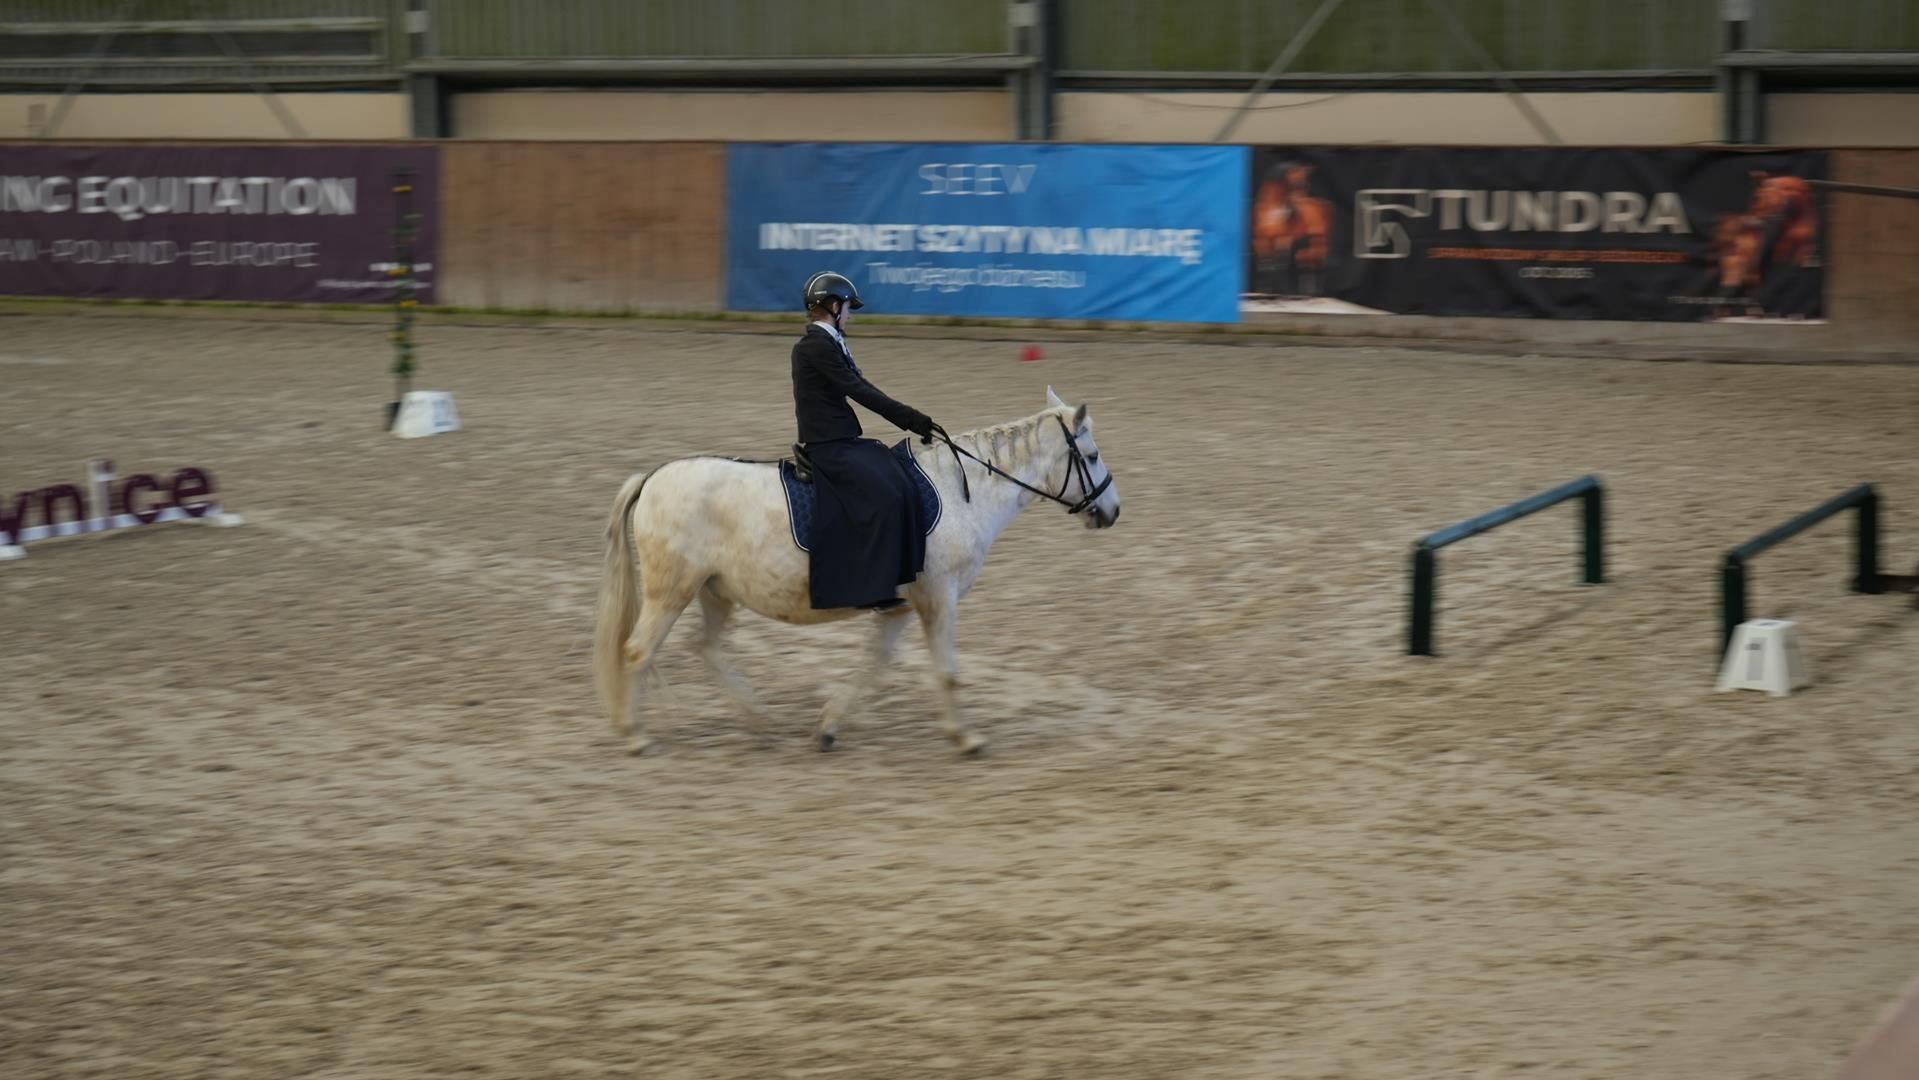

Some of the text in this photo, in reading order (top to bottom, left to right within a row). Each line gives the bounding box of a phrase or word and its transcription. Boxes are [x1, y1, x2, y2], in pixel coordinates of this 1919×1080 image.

[77, 176, 357, 221] EQUITATION
[1430, 189, 1692, 234] TUNDRA
[191, 241, 320, 267] EUROPE
[760, 223, 917, 251] INTERNET
[917, 225, 1032, 254] SZYTY
[1028, 226, 1085, 256] NA
